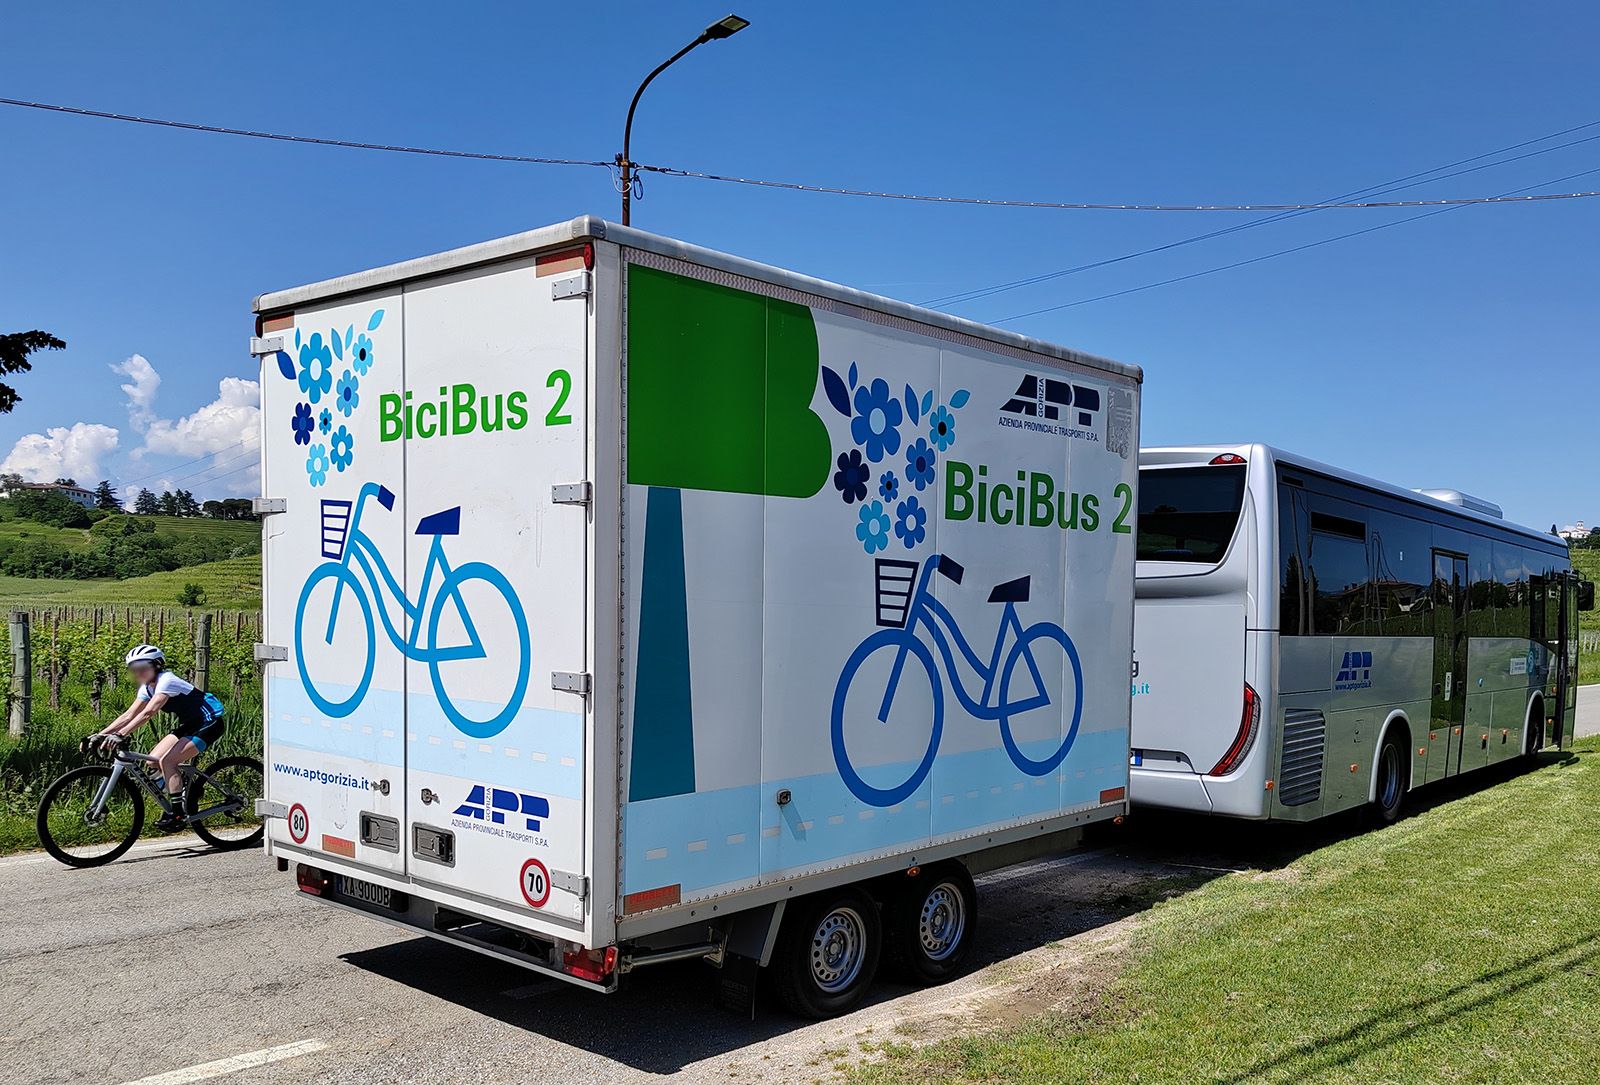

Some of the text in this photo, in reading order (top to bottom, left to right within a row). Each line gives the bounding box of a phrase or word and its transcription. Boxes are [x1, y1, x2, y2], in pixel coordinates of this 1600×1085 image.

[380, 369, 572, 442] BiciBus 2
[1000, 374, 1100, 427] APT
[998, 417, 1099, 442] AZIENDA PROVINCIALE TRASPORTI S.P.A.
[945, 460, 1133, 534] BiciBus 2
[273, 762, 370, 791] www.aptgorizia.it
[293, 815, 305, 831] 80
[452, 784, 550, 832] APT
[451, 818, 550, 848] AZIENDA PROVINCIALE TRASPORTI S.P.A.
[528, 873, 543, 894] 70
